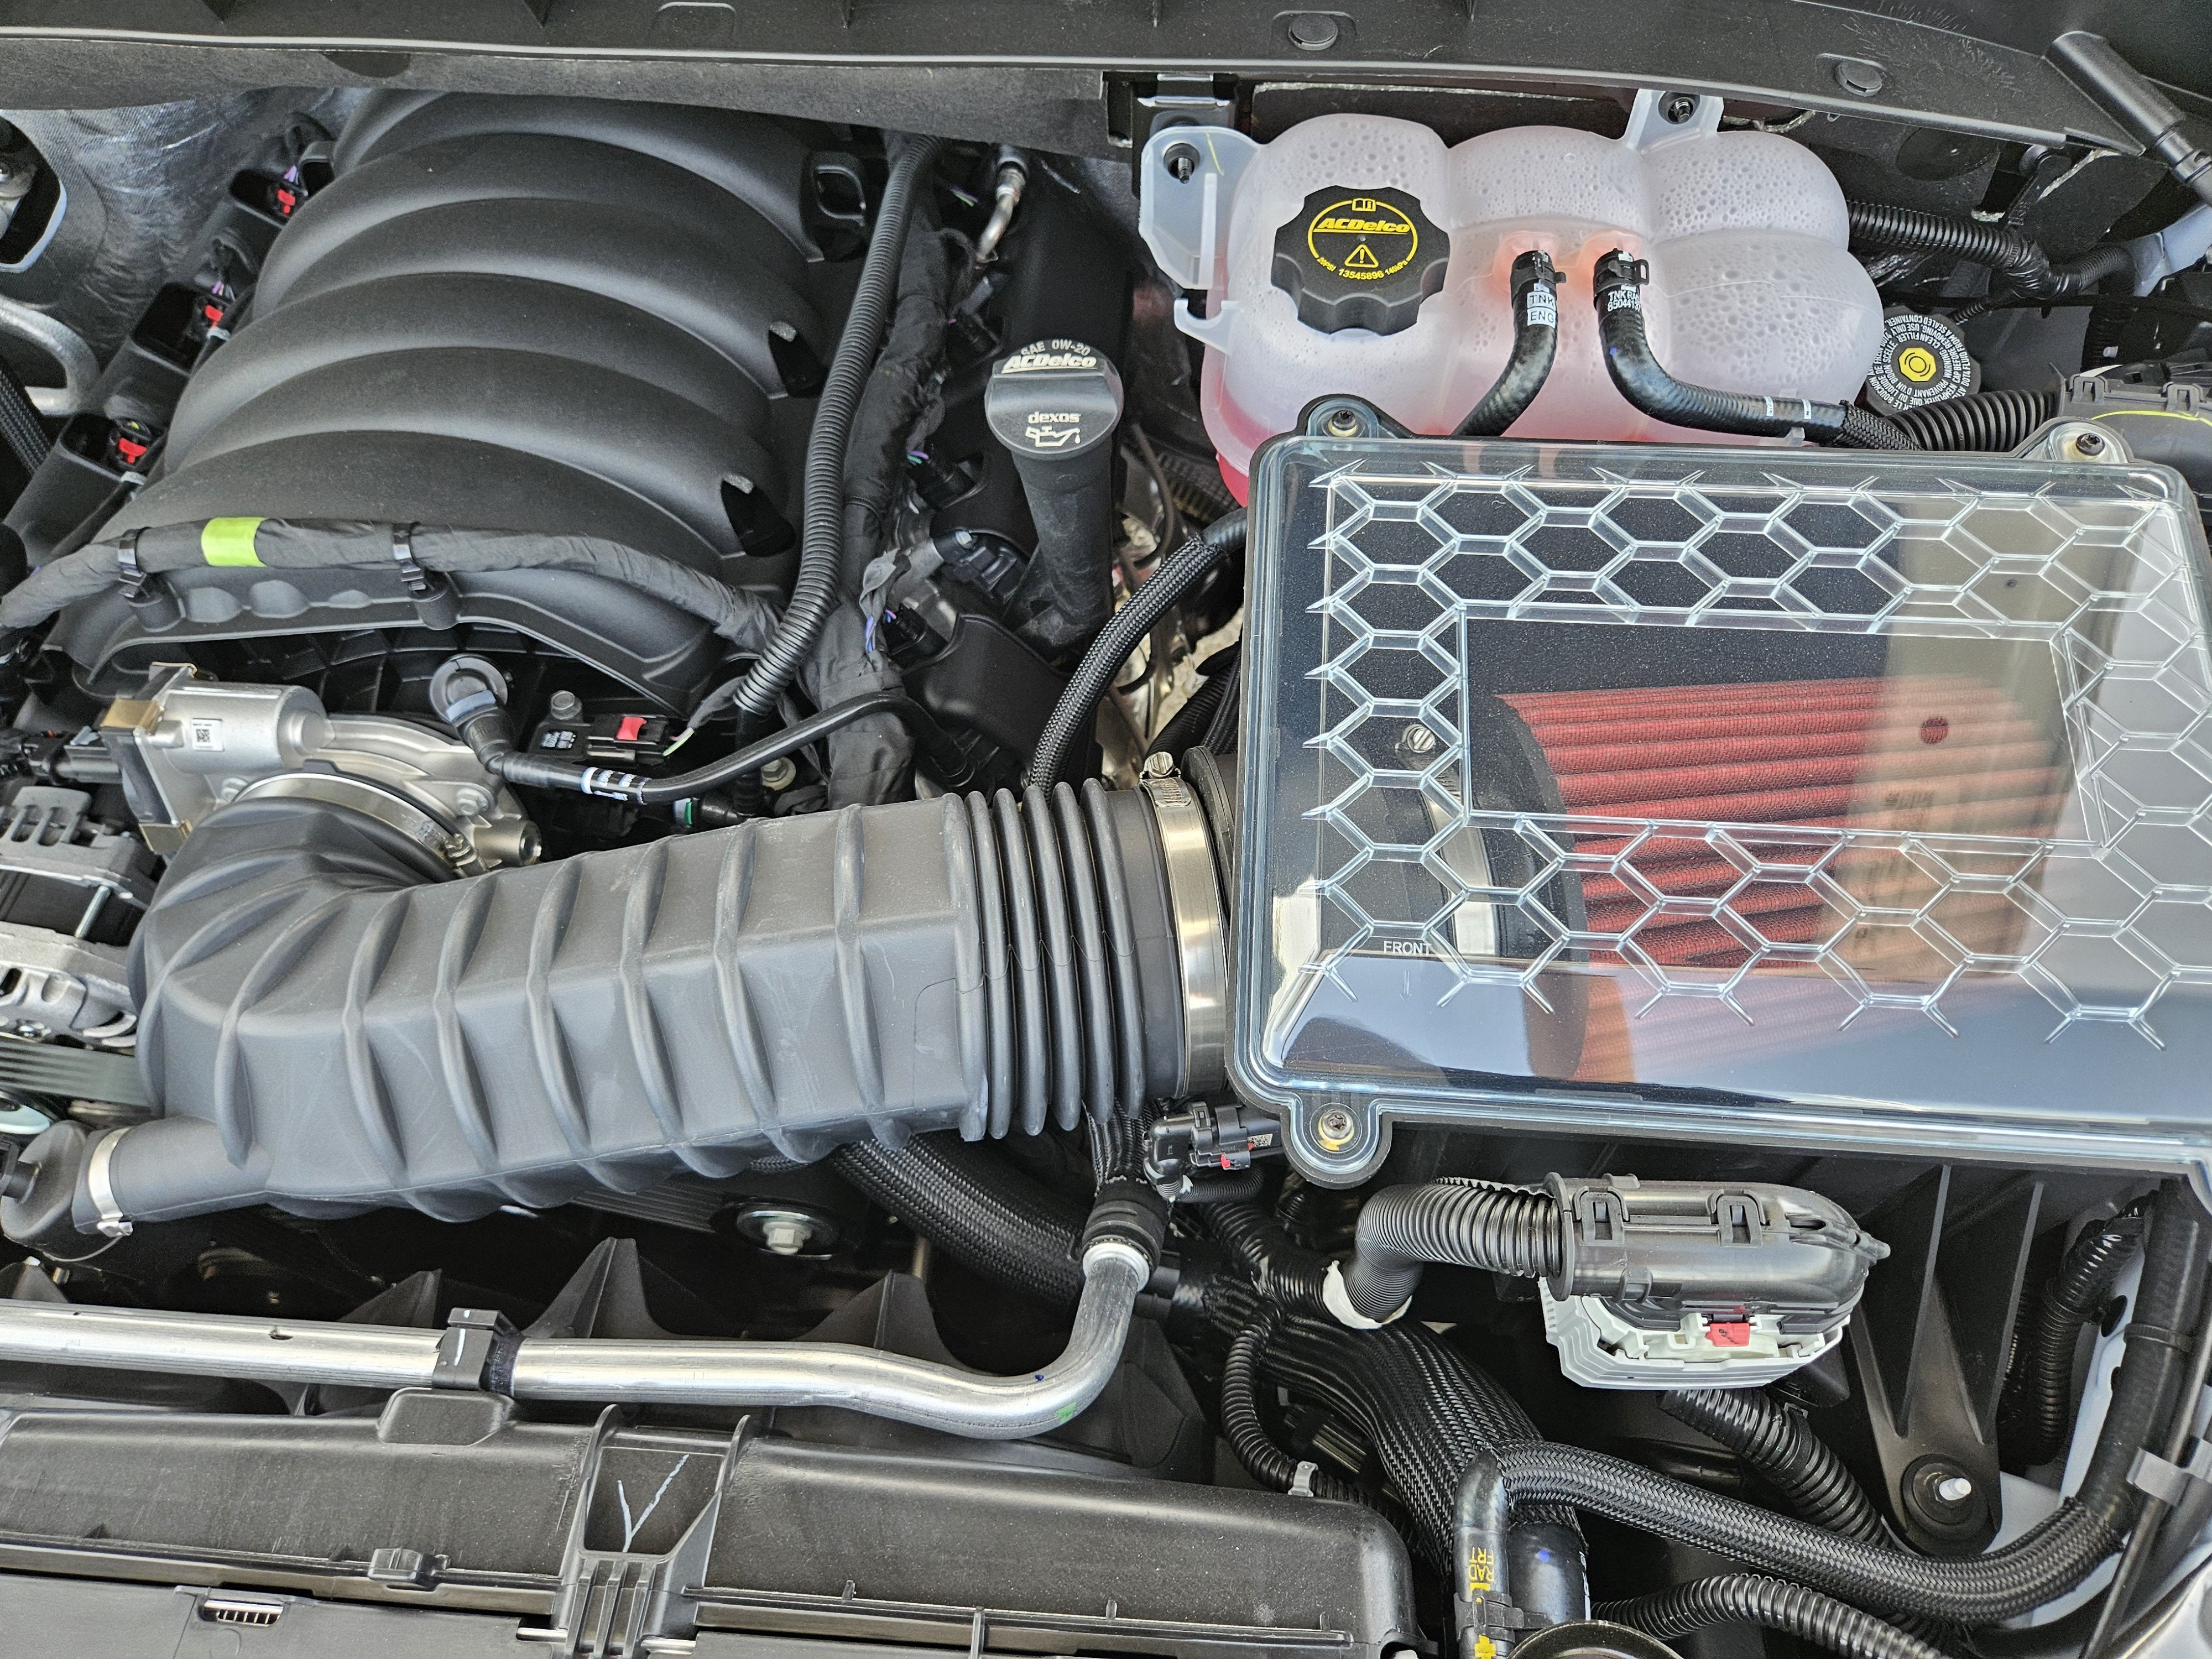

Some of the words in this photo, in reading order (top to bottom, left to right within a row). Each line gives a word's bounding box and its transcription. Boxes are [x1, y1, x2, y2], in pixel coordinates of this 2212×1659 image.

[1317, 218, 1410, 233] ACDelco
[1317, 257, 1337, 272] 20PSI
[1338, 268, 1385, 280] 13545896
[1529, 295, 1554, 307] TNK
[1608, 291, 1626, 301] TNK
[1530, 311, 1554, 323] ENG
[1923, 316, 1948, 333] SEALED
[1890, 324, 1907, 336] ONLY
[1907, 323, 1919, 332] USE
[1896, 333, 1919, 342] FILLER
[1919, 333, 1940, 349] CLEAN
[1948, 333, 1965, 351] FROM
[1021, 341, 1046, 356] SAE
[1051, 338, 1091, 356] 0W-20
[1003, 353, 1097, 369] ACDelco
[1939, 346, 1952, 379] WARNING:
[1948, 347, 1961, 371] BEFORE
[1960, 351, 1970, 370] FLUID
[1874, 364, 1883, 374] DE
[1884, 364, 1898, 384] BIDON
[1952, 371, 1961, 383] CAP
[1869, 374, 1894, 403] BOUCHON
[1878, 373, 1899, 397] LIQUIDE
[1896, 382, 1913, 394] D'UN
[1913, 379, 1948, 398] PROVENANT
[1892, 399, 1902, 410] LE
[1898, 394, 1908, 403] DU
[1910, 397, 1923, 406] QUE
[1028, 411, 1082, 424] dexos
[1384, 941, 1432, 957] FRONT
[1469, 1547, 1494, 1565] FRT
[1468, 1564, 1494, 1582] RAD
